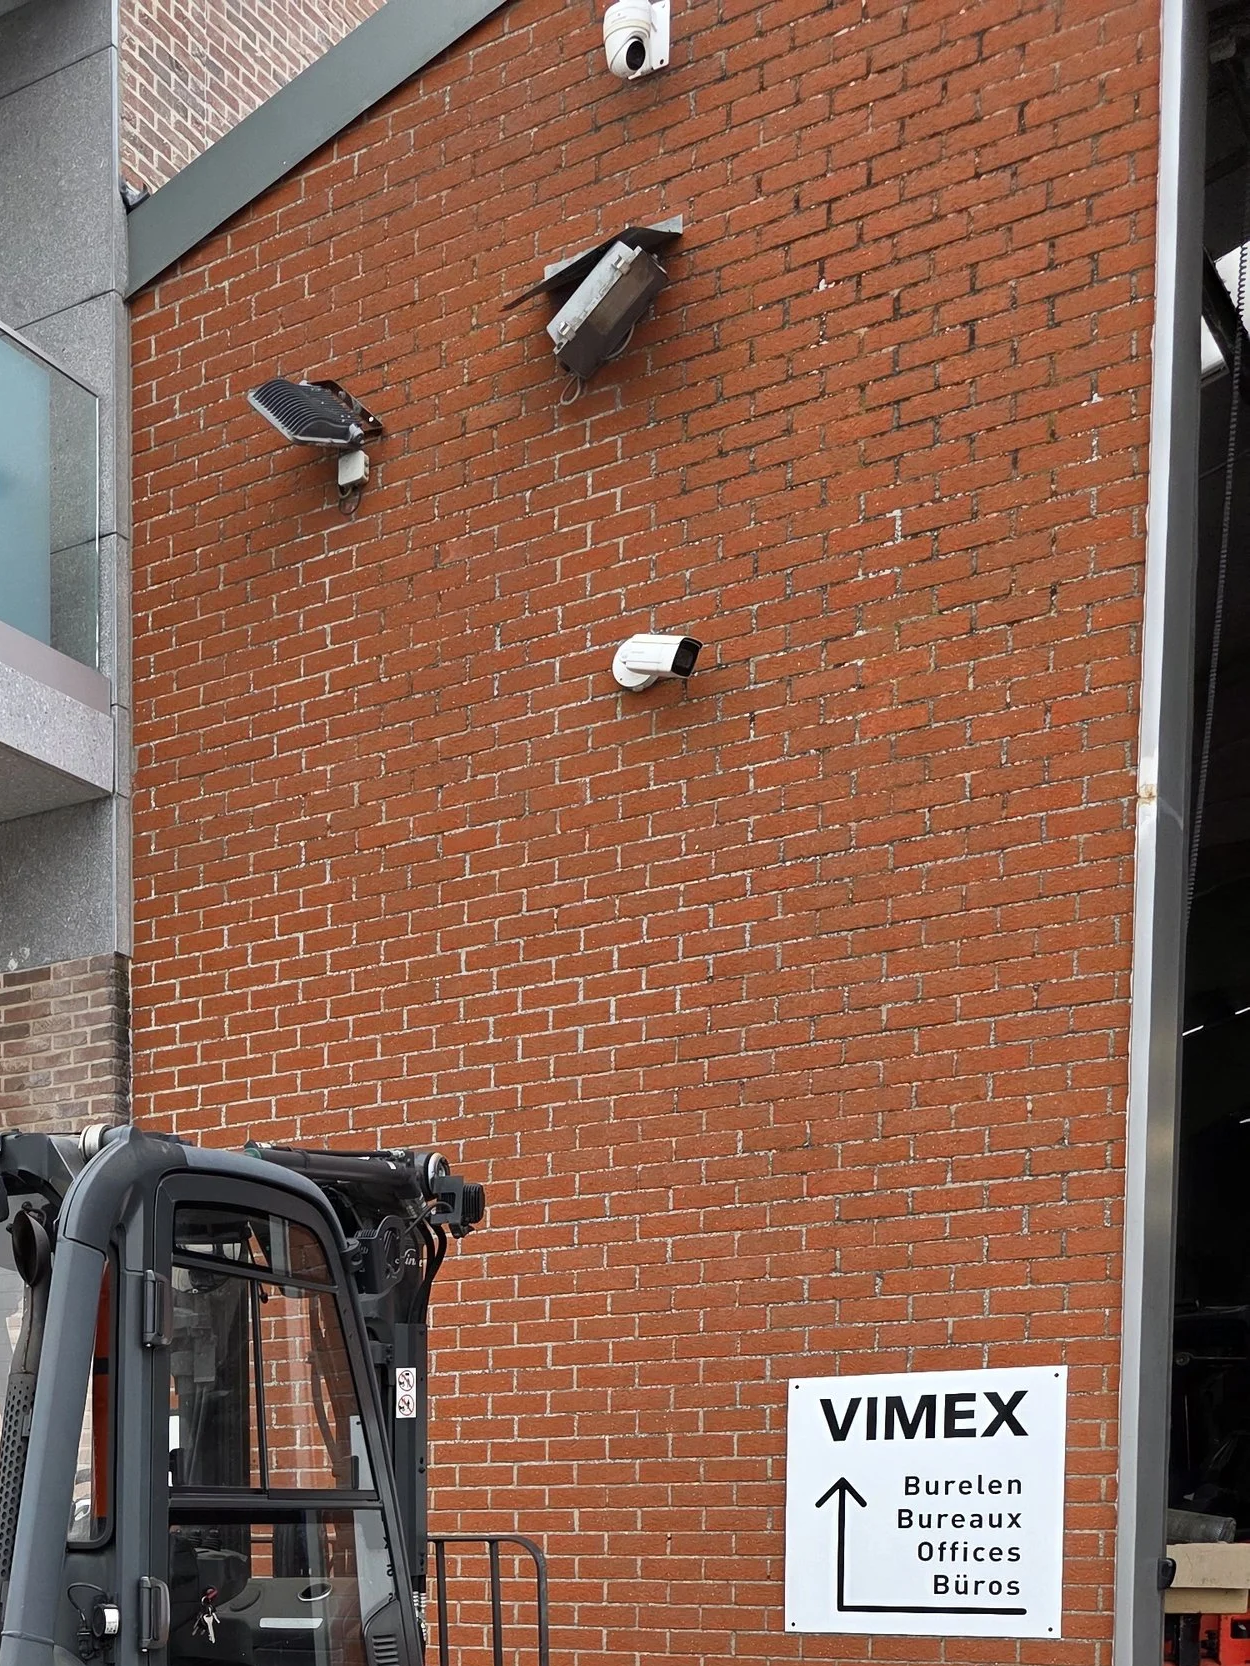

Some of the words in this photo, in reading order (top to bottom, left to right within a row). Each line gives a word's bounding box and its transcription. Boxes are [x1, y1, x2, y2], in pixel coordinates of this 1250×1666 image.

[819, 1390, 1029, 1442] VIMEX
[904, 1474, 1022, 1496] Burelen
[897, 1508, 1022, 1529] Bureaux
[917, 1541, 1021, 1562] Offices
[933, 1574, 1020, 1596] Büros
